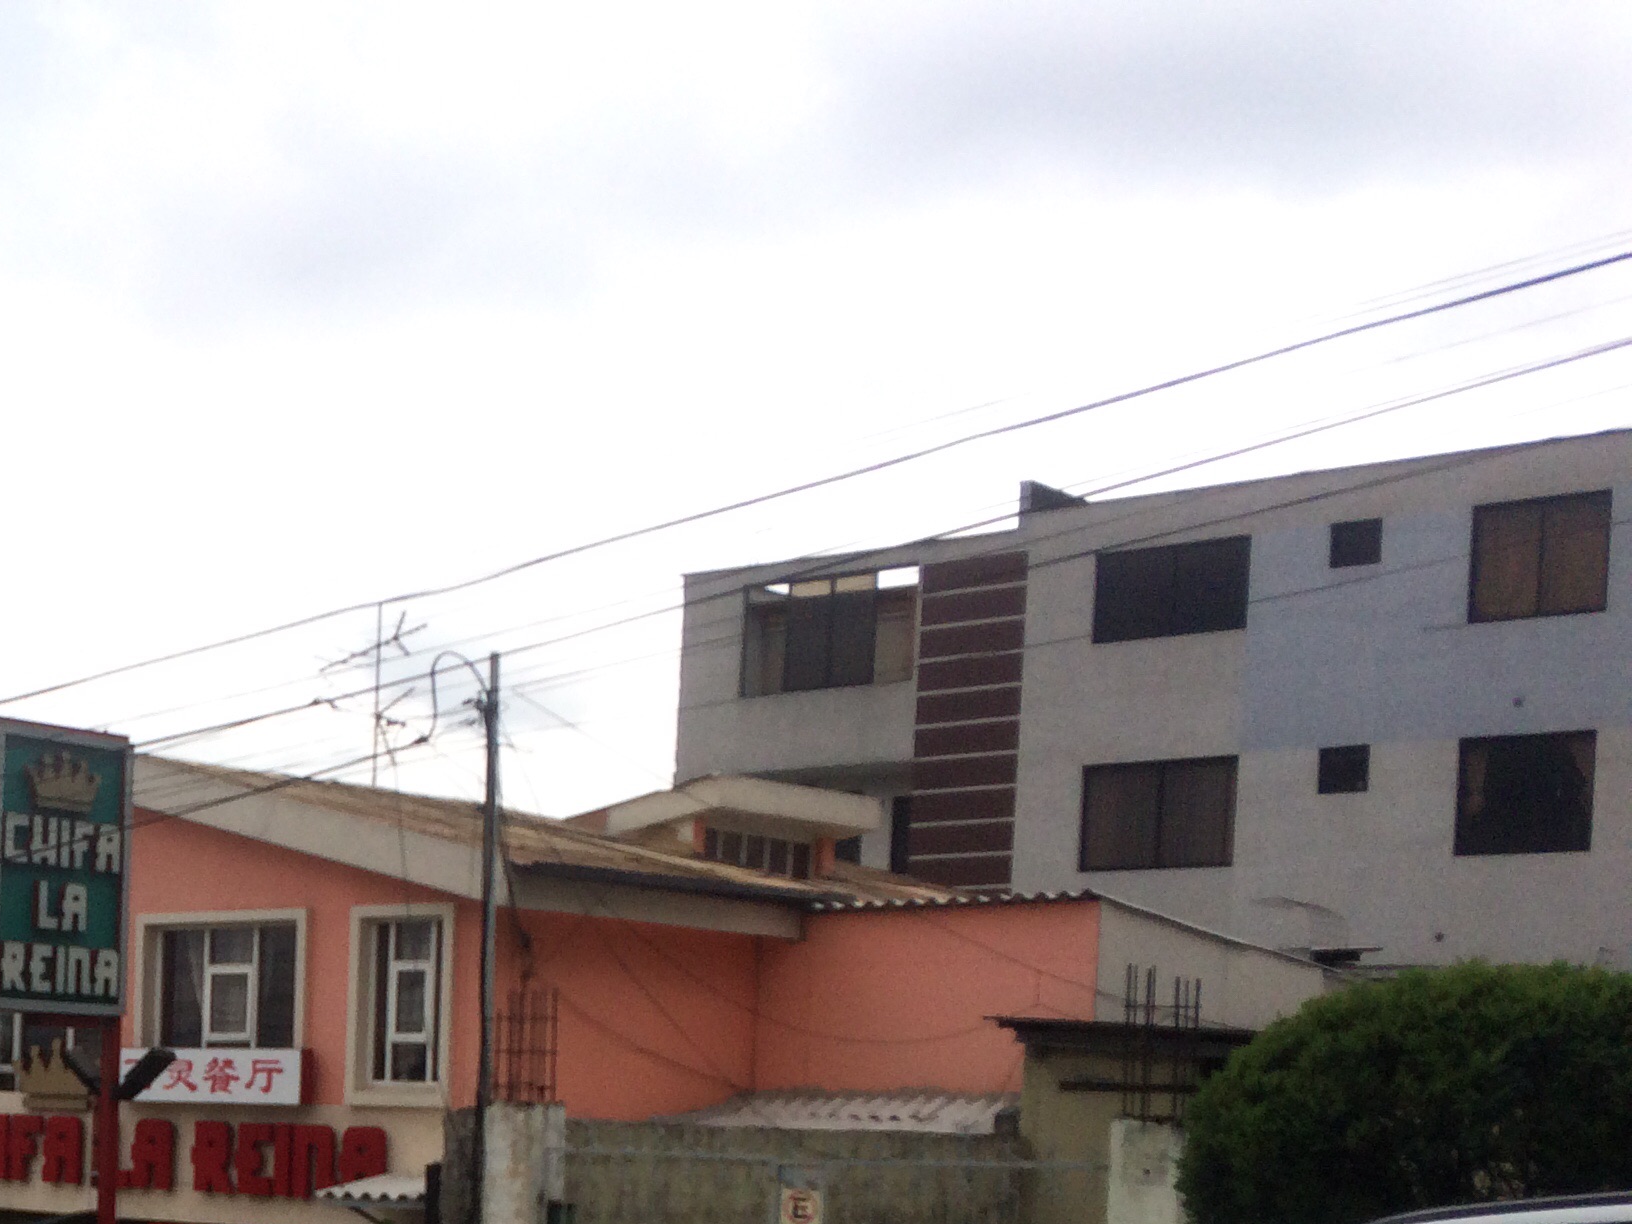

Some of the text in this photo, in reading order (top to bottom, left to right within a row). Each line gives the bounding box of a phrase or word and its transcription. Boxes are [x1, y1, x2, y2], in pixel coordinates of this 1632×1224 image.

[3, 811, 121, 874] CHIFA
[36, 880, 88, 932] LA
[0, 940, 120, 998] REINA
[191, 1120, 388, 1199] REINA
